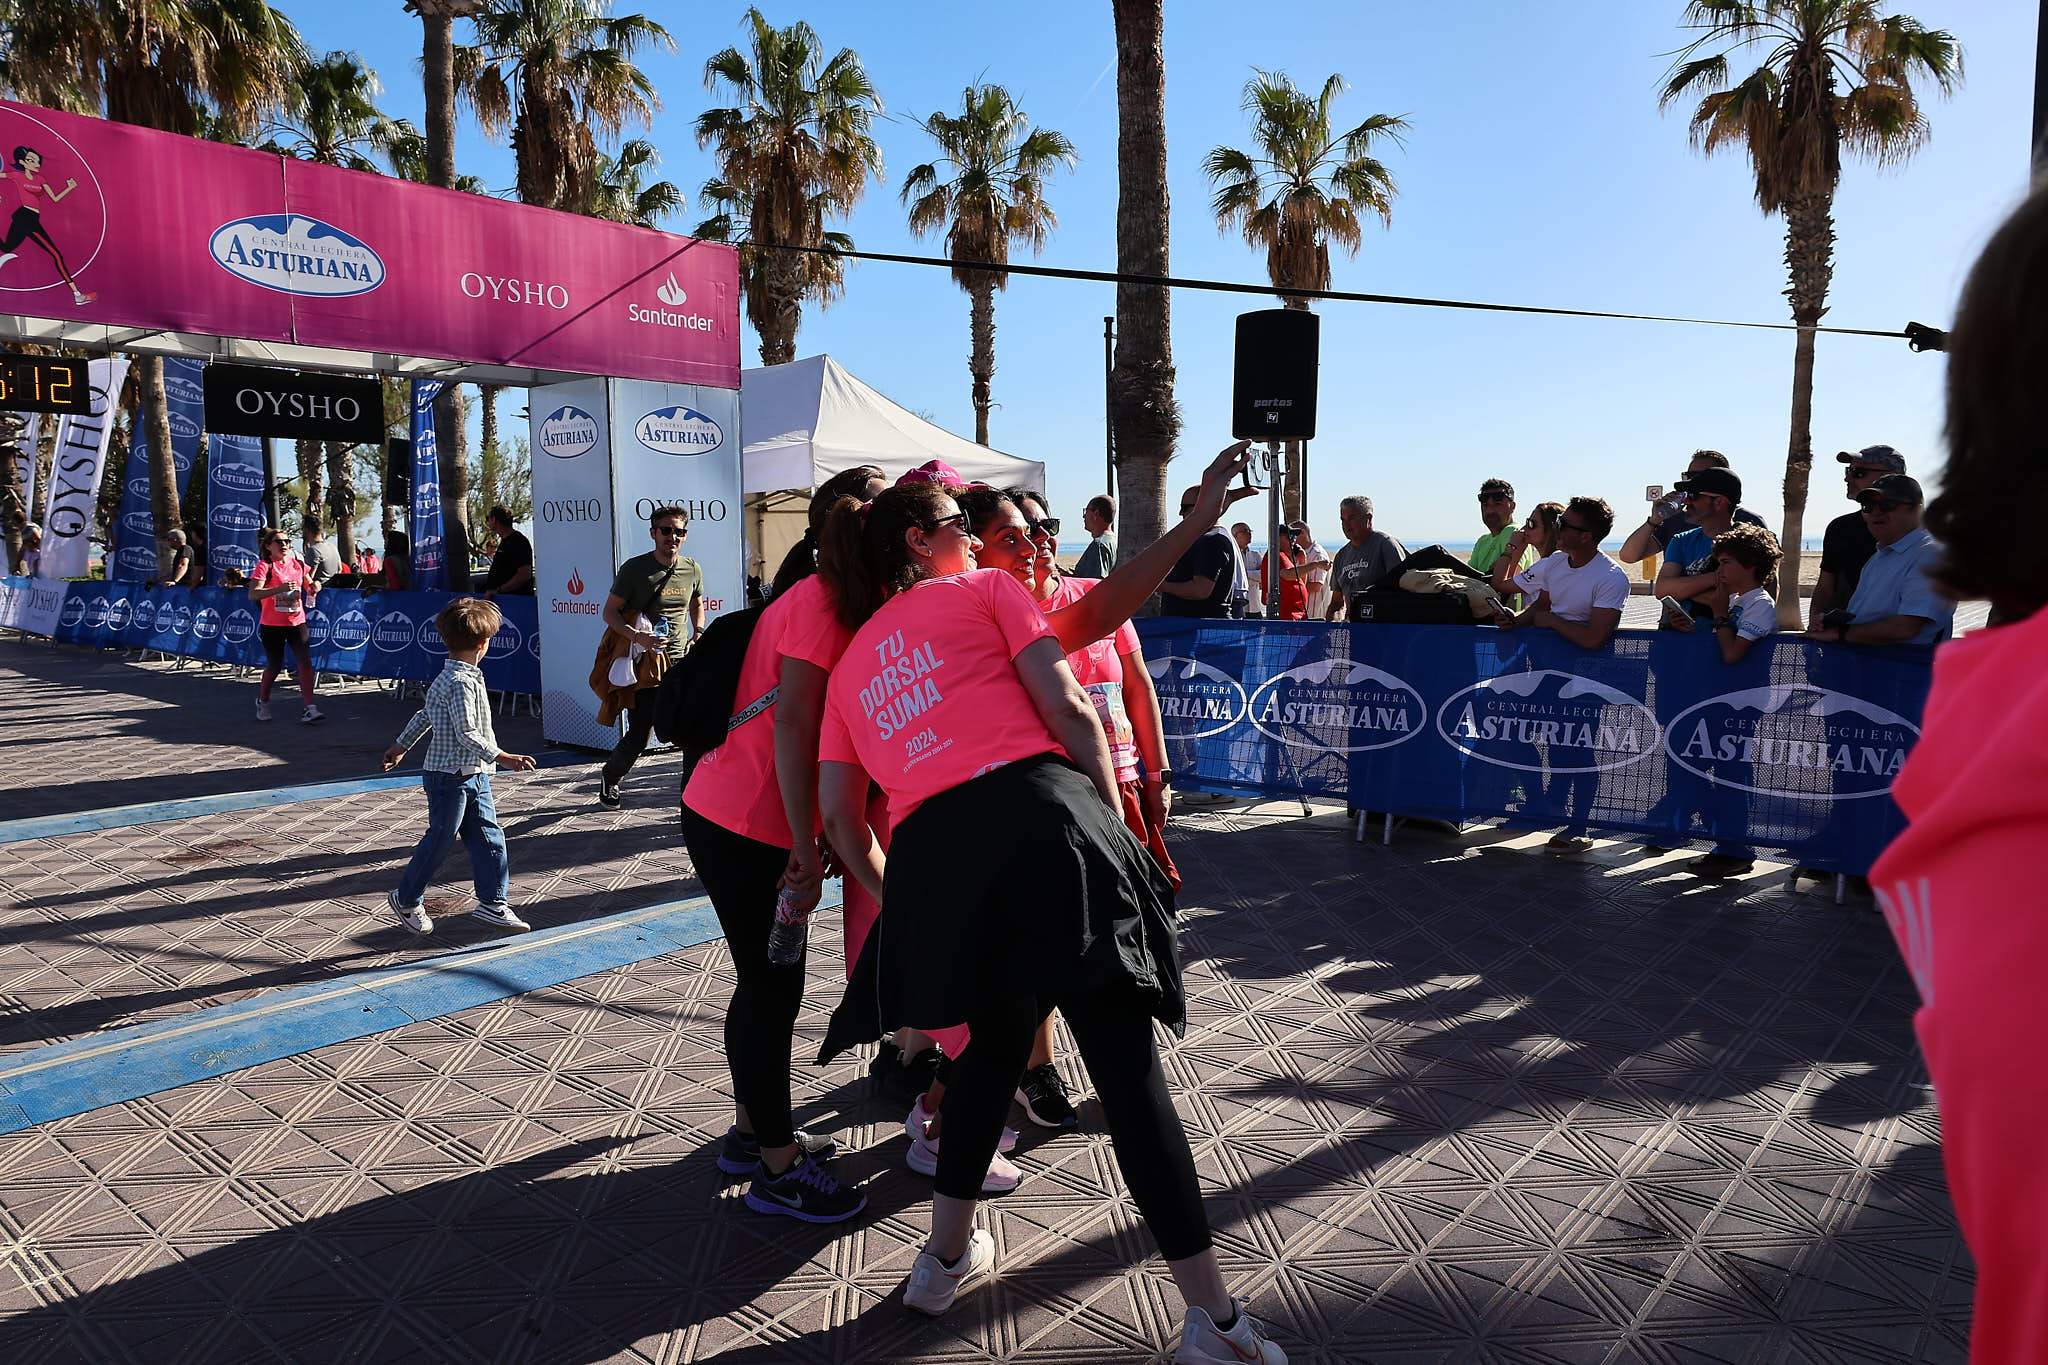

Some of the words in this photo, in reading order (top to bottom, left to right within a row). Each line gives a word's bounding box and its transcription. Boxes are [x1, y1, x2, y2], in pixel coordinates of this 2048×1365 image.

[224, 234, 374, 283] ASTURIANA
[252, 235, 306, 251] CENTRAL
[313, 243, 367, 259] LECHERA
[460, 272, 569, 309] OYSHO
[628, 303, 713, 332] Santander
[235, 388, 360, 421] OYSHO
[543, 428, 594, 447] ASTURIANA
[641, 422, 718, 445] ASTURIANA
[542, 498, 600, 523] OYSHO
[552, 598, 600, 615] Santander
[375, 625, 410, 642] ASTURIANA
[875, 629, 905, 666] TU
[858, 641, 944, 719] DORSAL
[1181, 684, 1232, 695] LECHERA
[875, 678, 943, 741] SUMA
[1257, 689, 1411, 732] ASTURIANA
[1289, 688, 1342, 700] CENTRAL
[1347, 691, 1407, 704] LECHERA
[1487, 700, 1554, 714] CENTRAL
[905, 727, 938, 757] 2024
[1450, 701, 1641, 754] ASTURIANA
[1680, 717, 1908, 777] ASTURIANA
